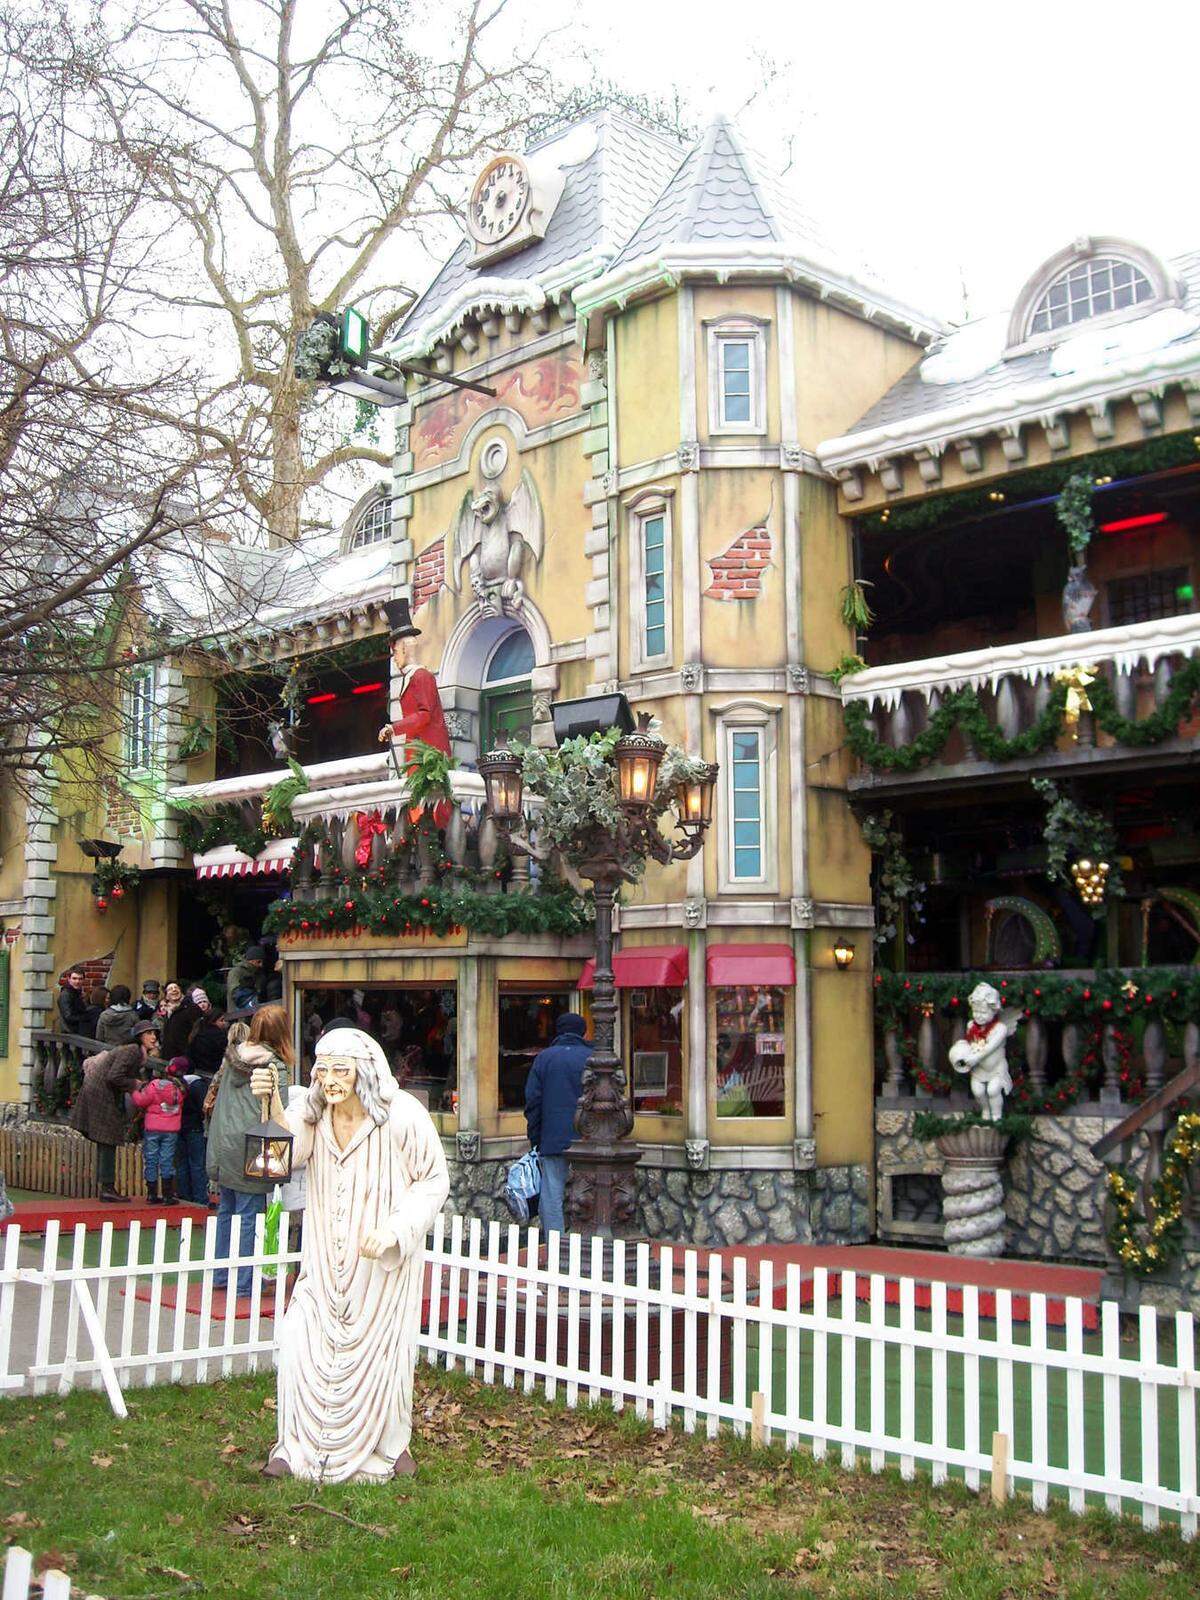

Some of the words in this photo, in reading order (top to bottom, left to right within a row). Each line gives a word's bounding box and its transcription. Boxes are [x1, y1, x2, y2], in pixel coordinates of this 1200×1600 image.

[508, 164, 513, 177] 1
[516, 171, 523, 184] 2
[519, 182, 526, 195] 3
[488, 221, 494, 235] 7
[498, 220, 504, 233] 6
